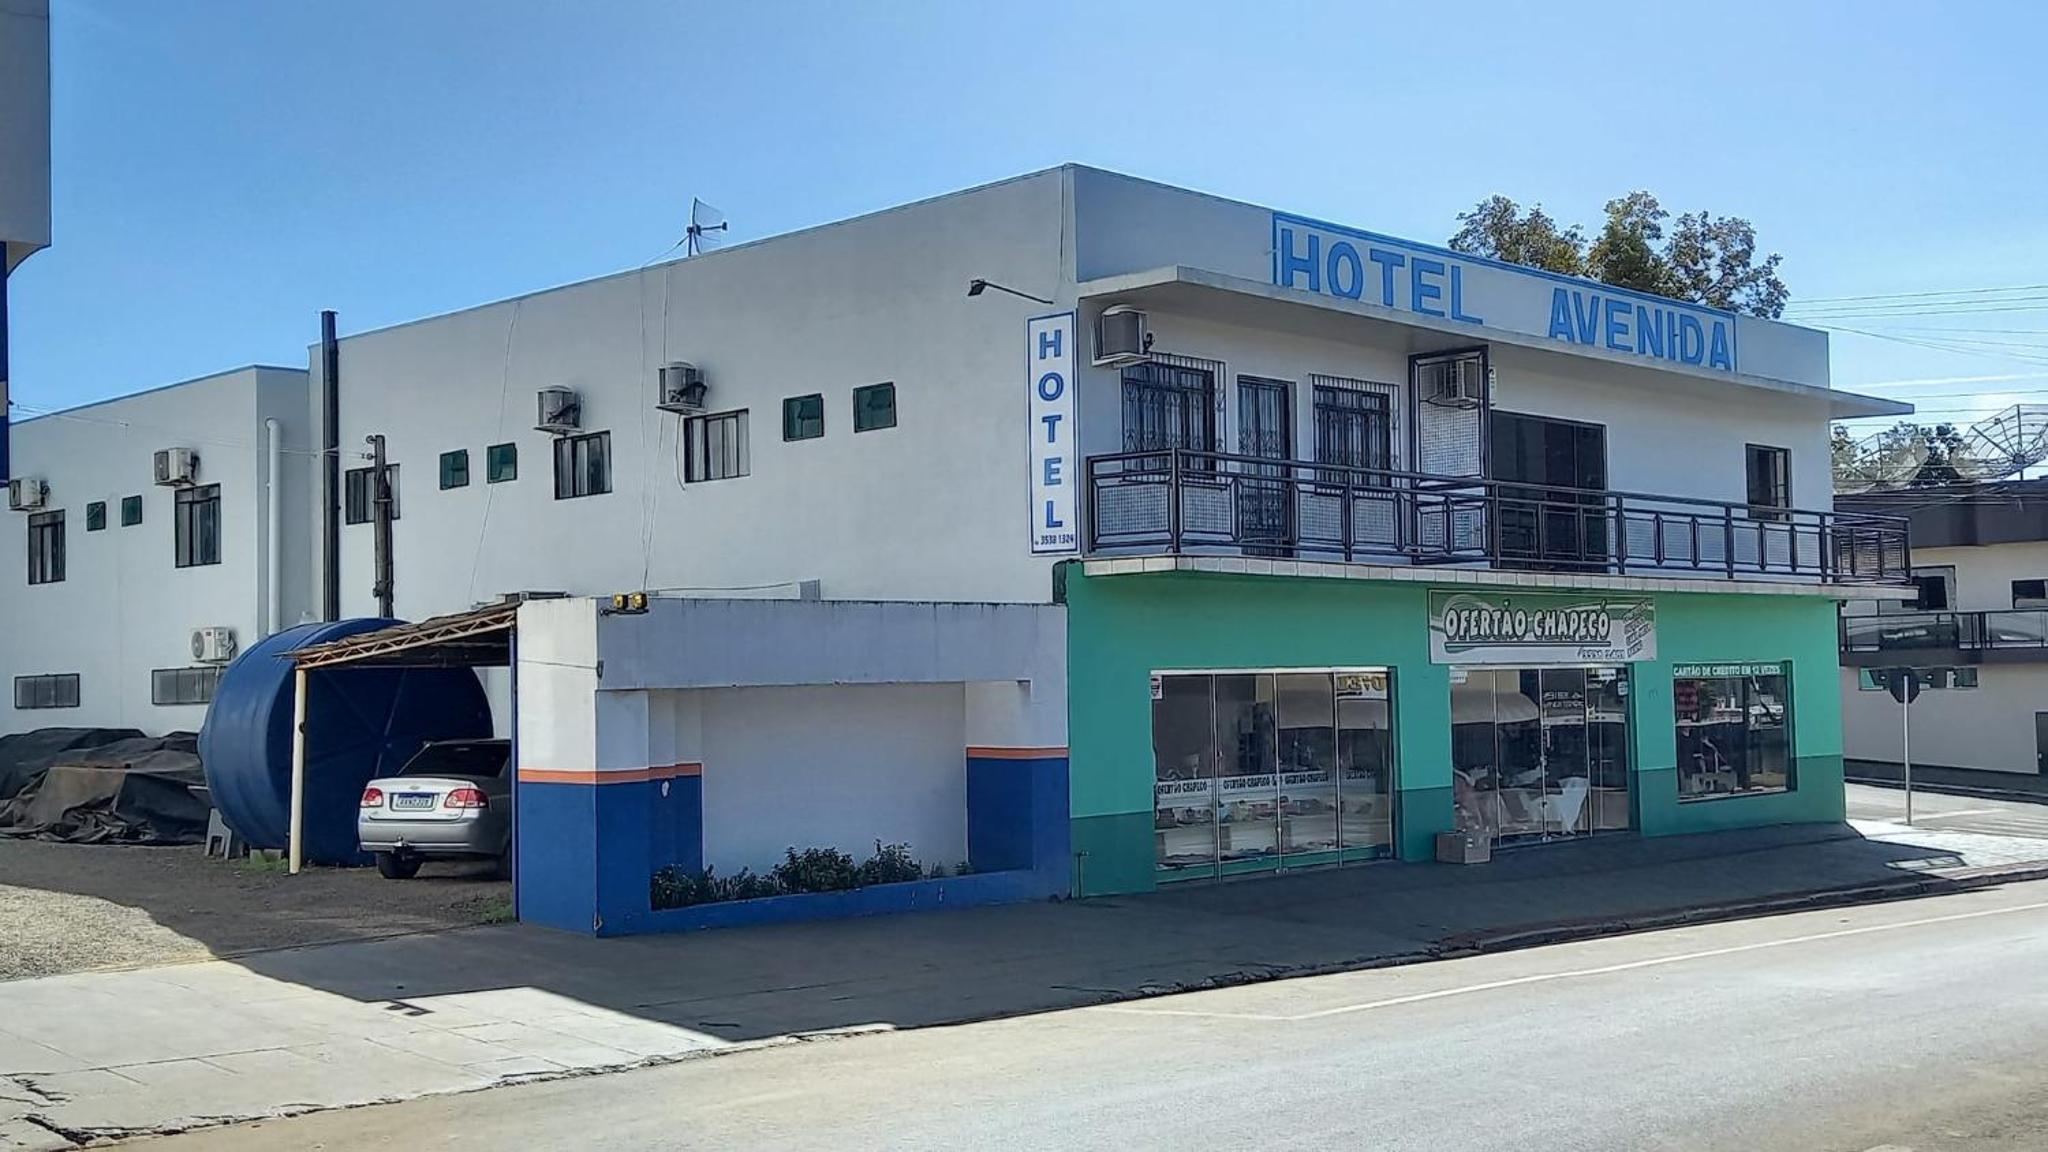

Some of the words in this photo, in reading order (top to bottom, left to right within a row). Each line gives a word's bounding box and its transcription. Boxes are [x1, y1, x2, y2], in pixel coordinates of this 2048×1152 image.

[1281, 227, 1484, 326] HOTEL
[1549, 287, 1732, 371] AVENIDA
[1038, 328, 1064, 529] HOTEL
[1533, 598, 1611, 641] CHAPECÓ
